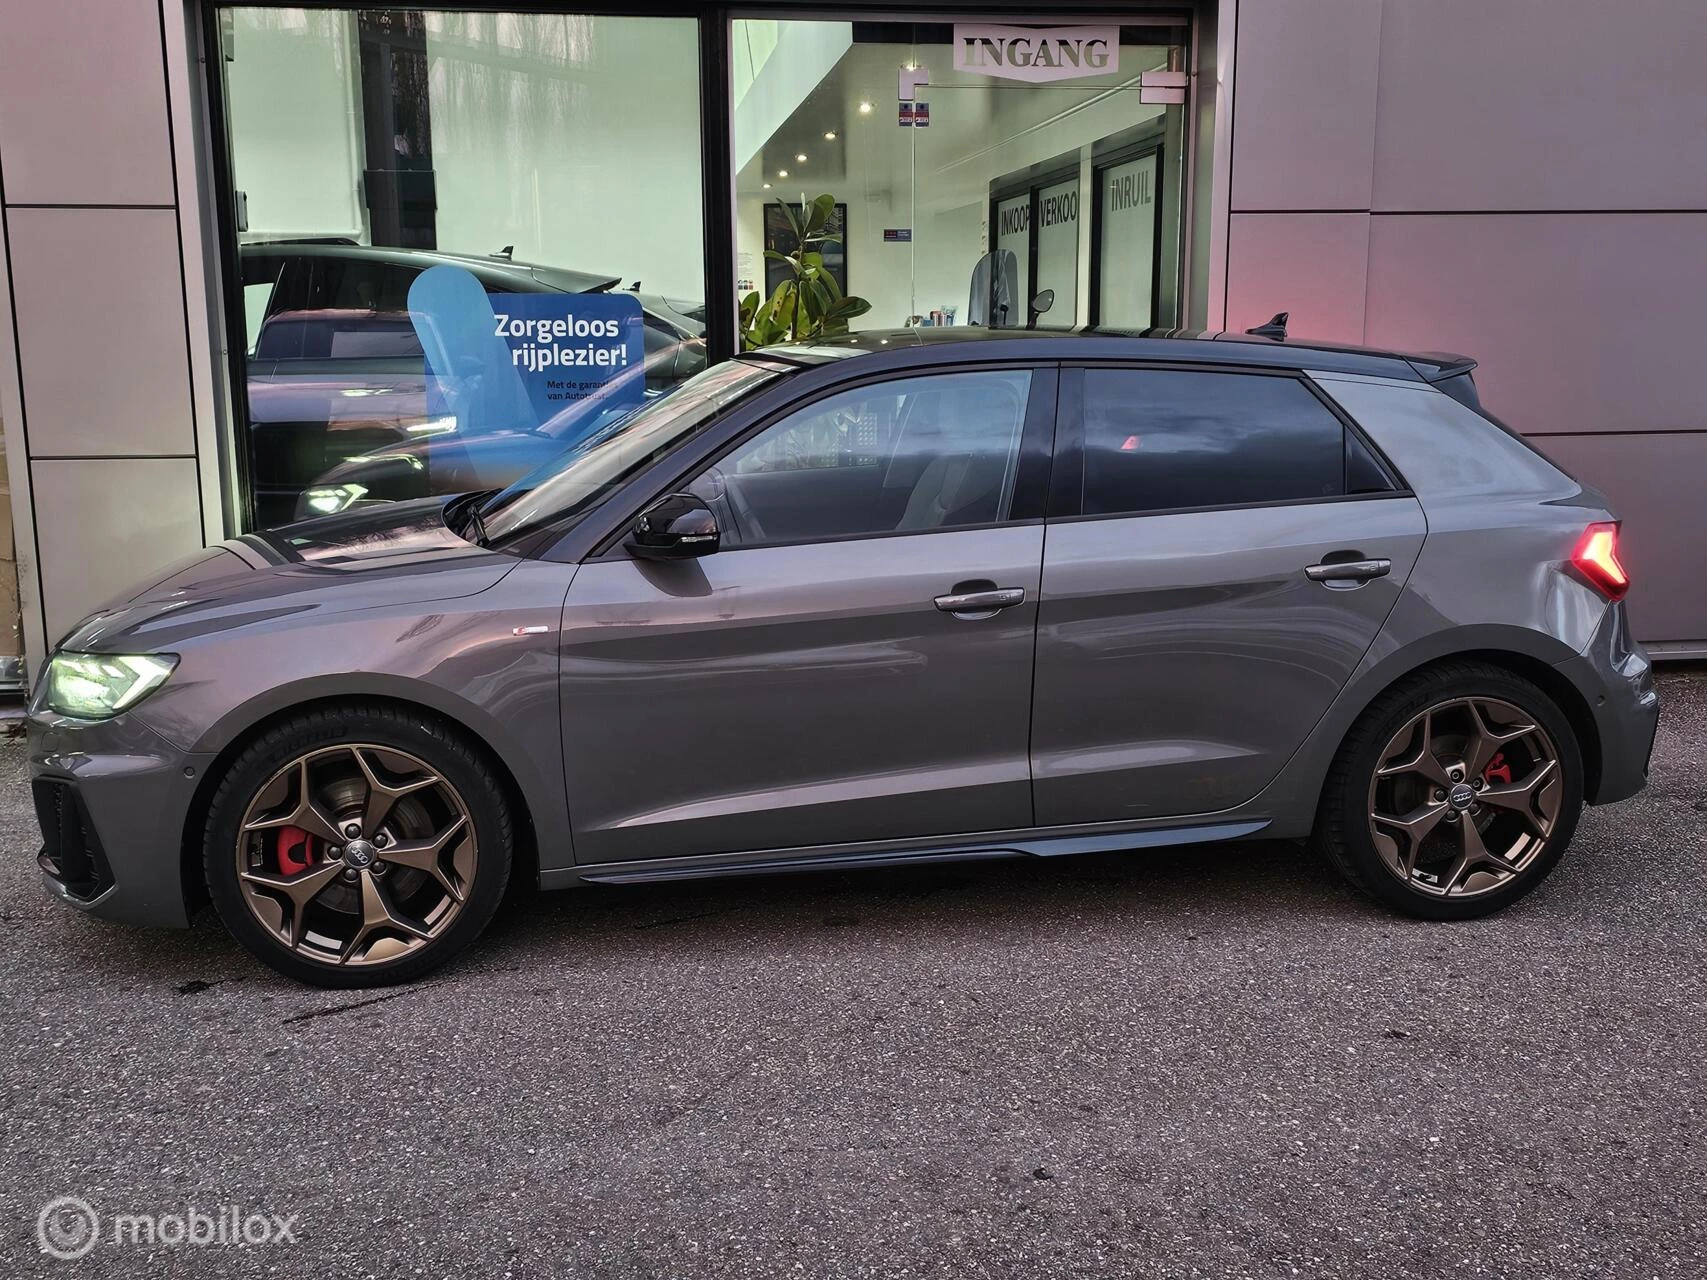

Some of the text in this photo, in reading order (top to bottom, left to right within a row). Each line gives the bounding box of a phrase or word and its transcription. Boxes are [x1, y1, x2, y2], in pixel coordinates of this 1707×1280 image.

[963, 37, 1109, 68] INGANG
[1111, 170, 1151, 212] INRUIL
[1040, 191, 1078, 228] VERKOO
[494, 314, 619, 343] Zorgeloos
[512, 343, 627, 371] rijplezier!
[547, 380, 564, 389] Met
[566, 380, 577, 389] de
